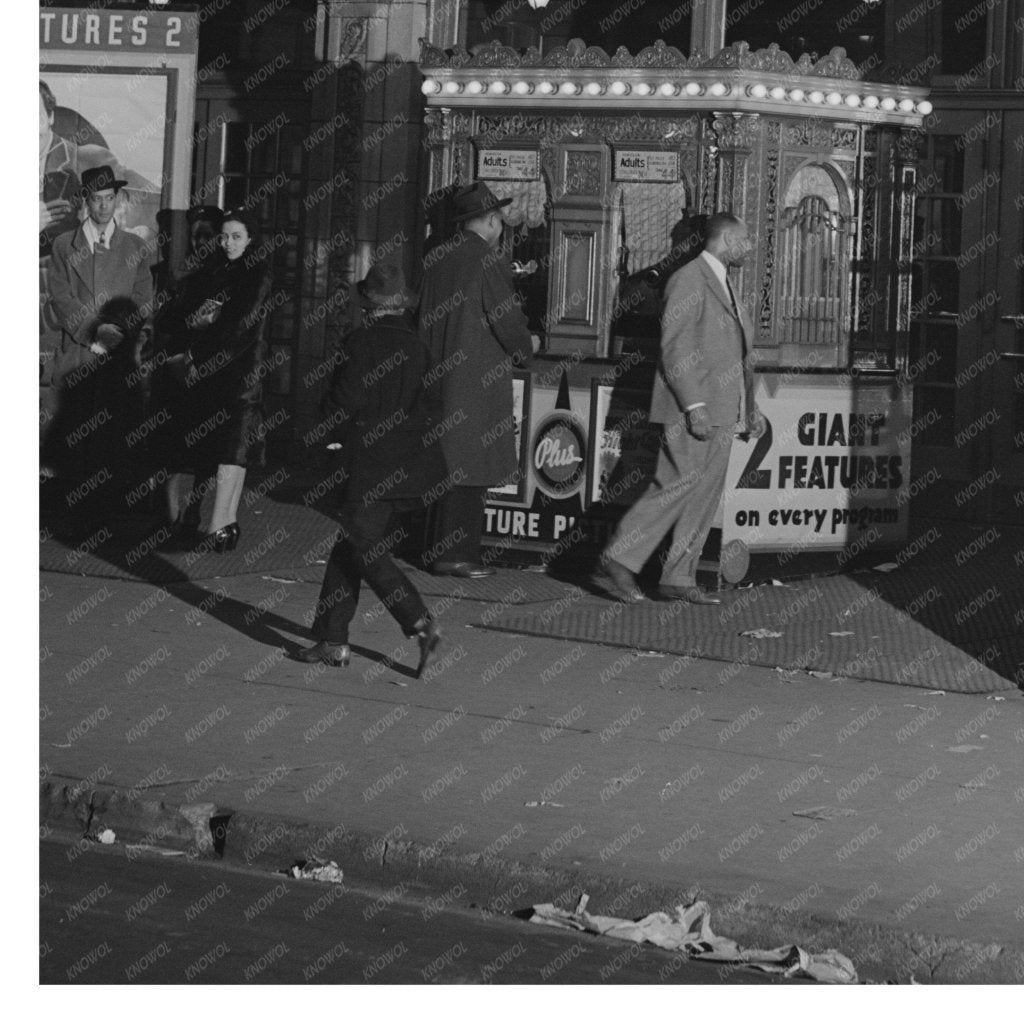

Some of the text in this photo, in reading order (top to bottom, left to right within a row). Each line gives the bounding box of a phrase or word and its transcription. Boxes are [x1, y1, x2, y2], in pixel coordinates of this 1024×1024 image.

[40, 13, 182, 47] TURES 2
[483, 156, 508, 167] Adults
[620, 157, 646, 168] Adults
[797, 412, 886, 447] GIANT
[534, 437, 584, 470] Plus
[735, 413, 904, 490] 2 FEATURES
[484, 507, 541, 538] TURE
[735, 506, 899, 534] on every program
